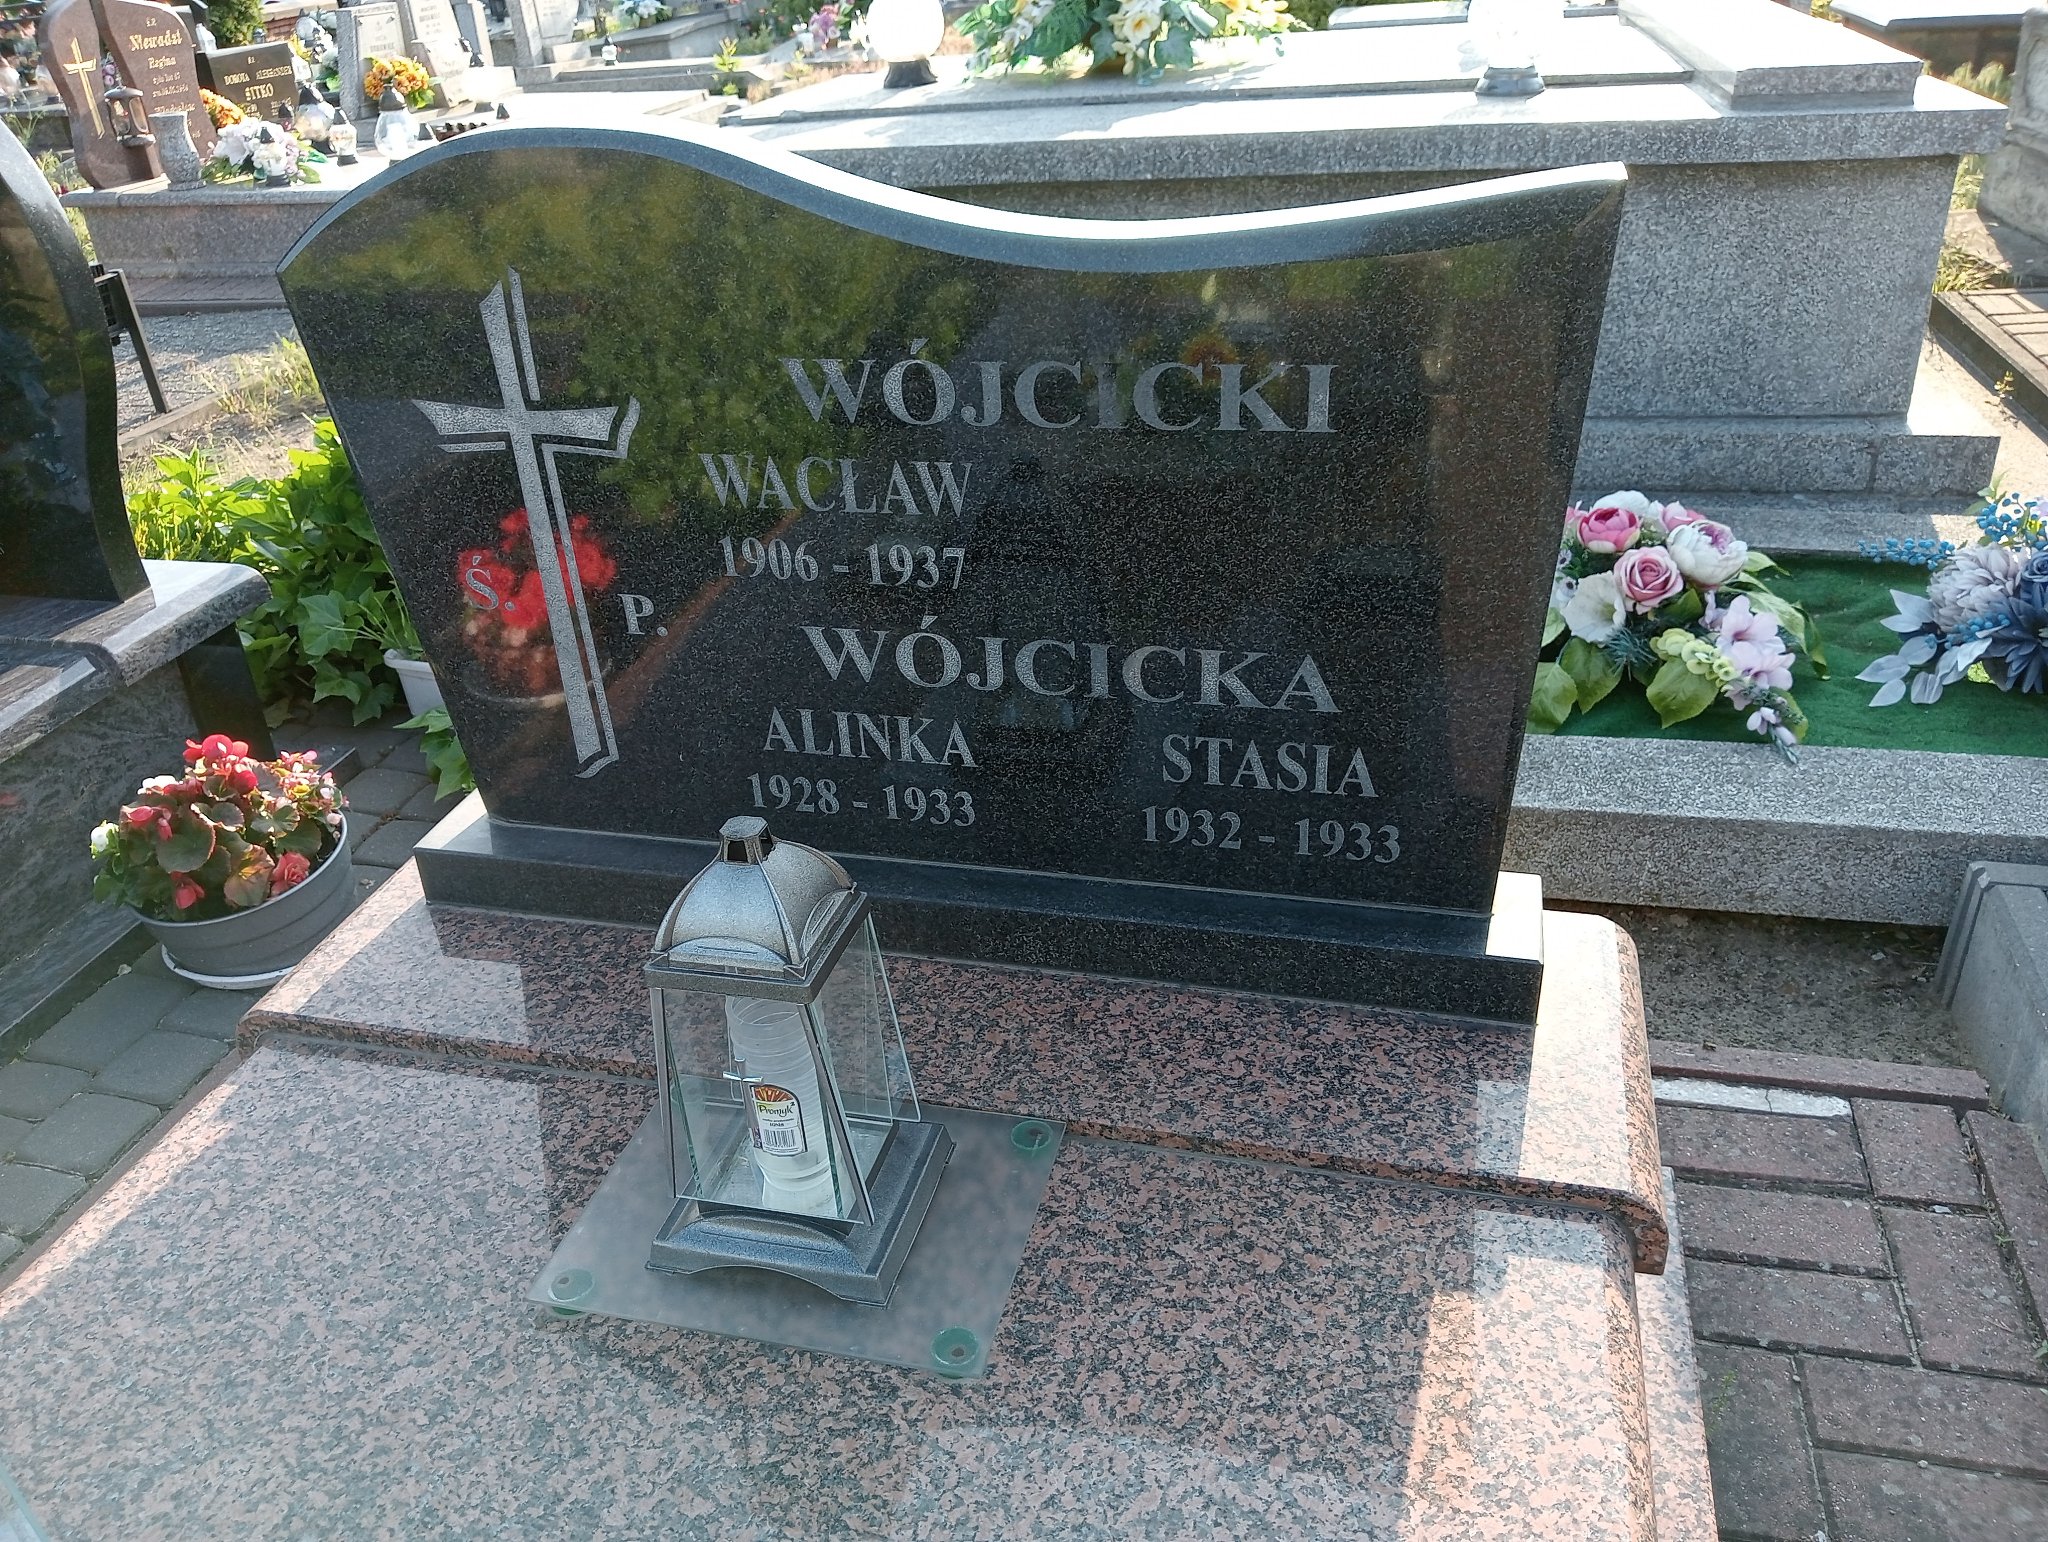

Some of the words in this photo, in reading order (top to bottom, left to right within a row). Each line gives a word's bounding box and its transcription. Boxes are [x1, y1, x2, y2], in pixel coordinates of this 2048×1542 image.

[777, 338, 1338, 433] WÓJCICKI
[698, 453, 972, 518] WACŁAW
[465, 555, 516, 610] Ś.
[617, 593, 668, 637] P.
[718, 535, 819, 581] 1906
[864, 542, 966, 590] 1937
[800, 615, 1342, 713] WÓJCICKA
[763, 706, 979, 768] ALINKA
[1162, 733, 1379, 798] STASIA
[748, 772, 840, 815] 1928
[882, 784, 976, 827] 1933
[1142, 804, 1242, 850] 1932
[1294, 818, 1401, 864] 1933
